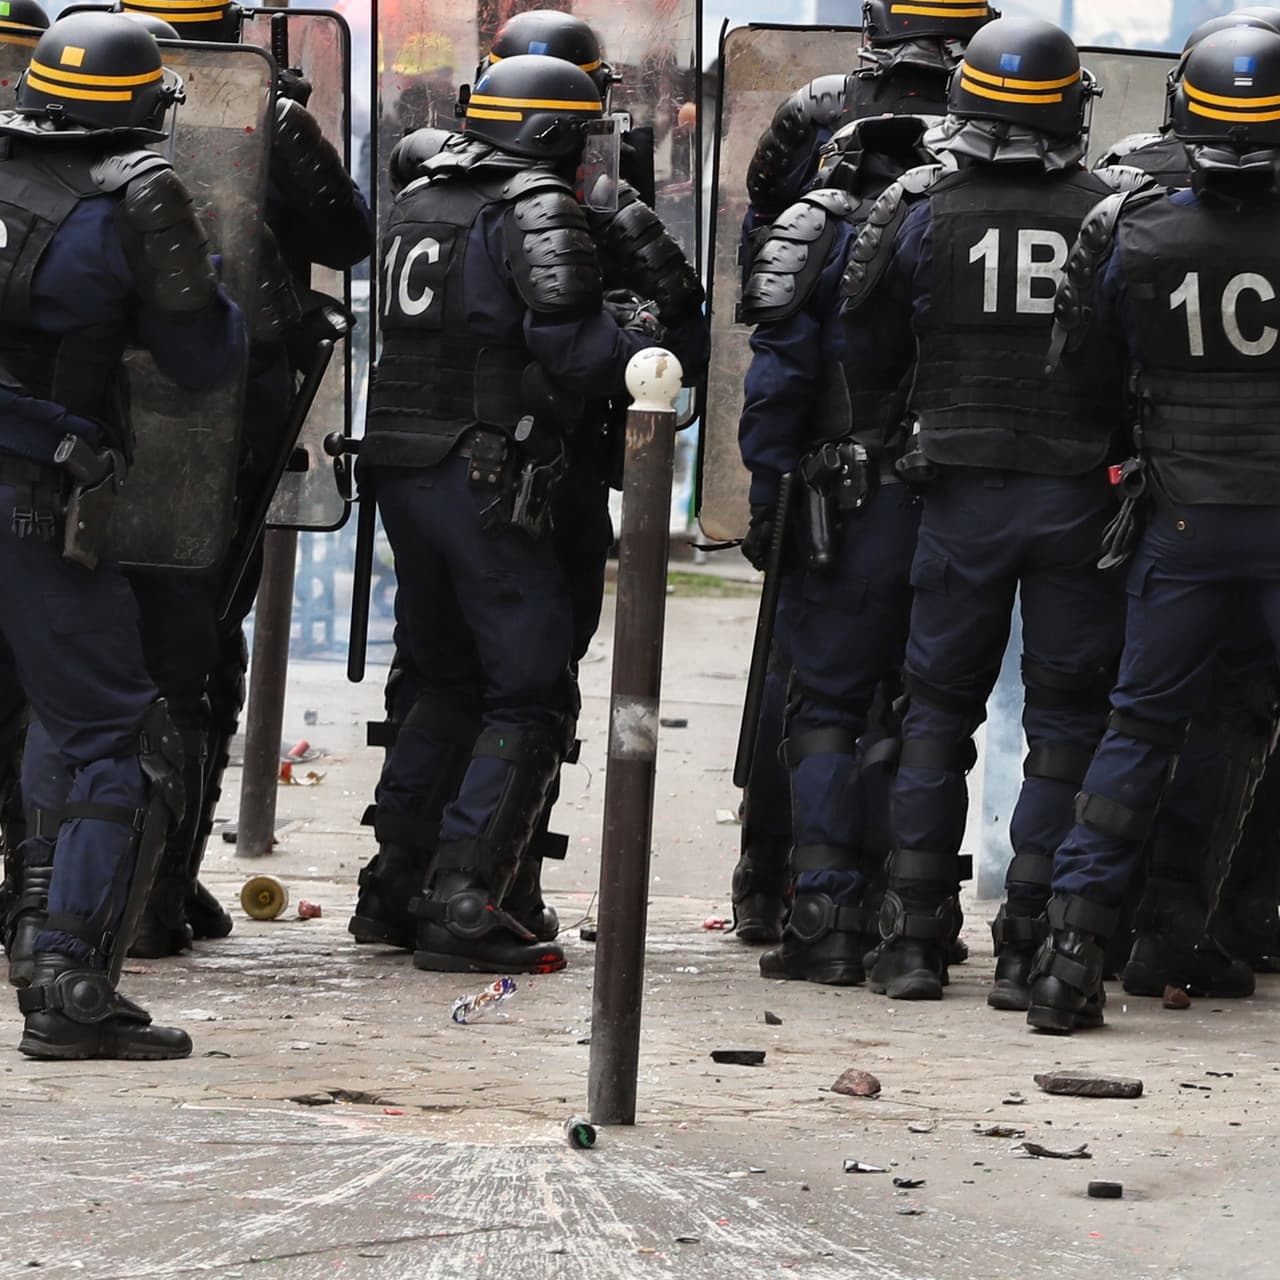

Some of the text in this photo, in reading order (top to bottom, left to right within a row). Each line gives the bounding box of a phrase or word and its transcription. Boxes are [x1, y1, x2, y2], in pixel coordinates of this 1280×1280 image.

[383, 235, 440, 316] 1C
[968, 228, 1069, 314] 1B
[1169, 271, 1279, 357] 1C
